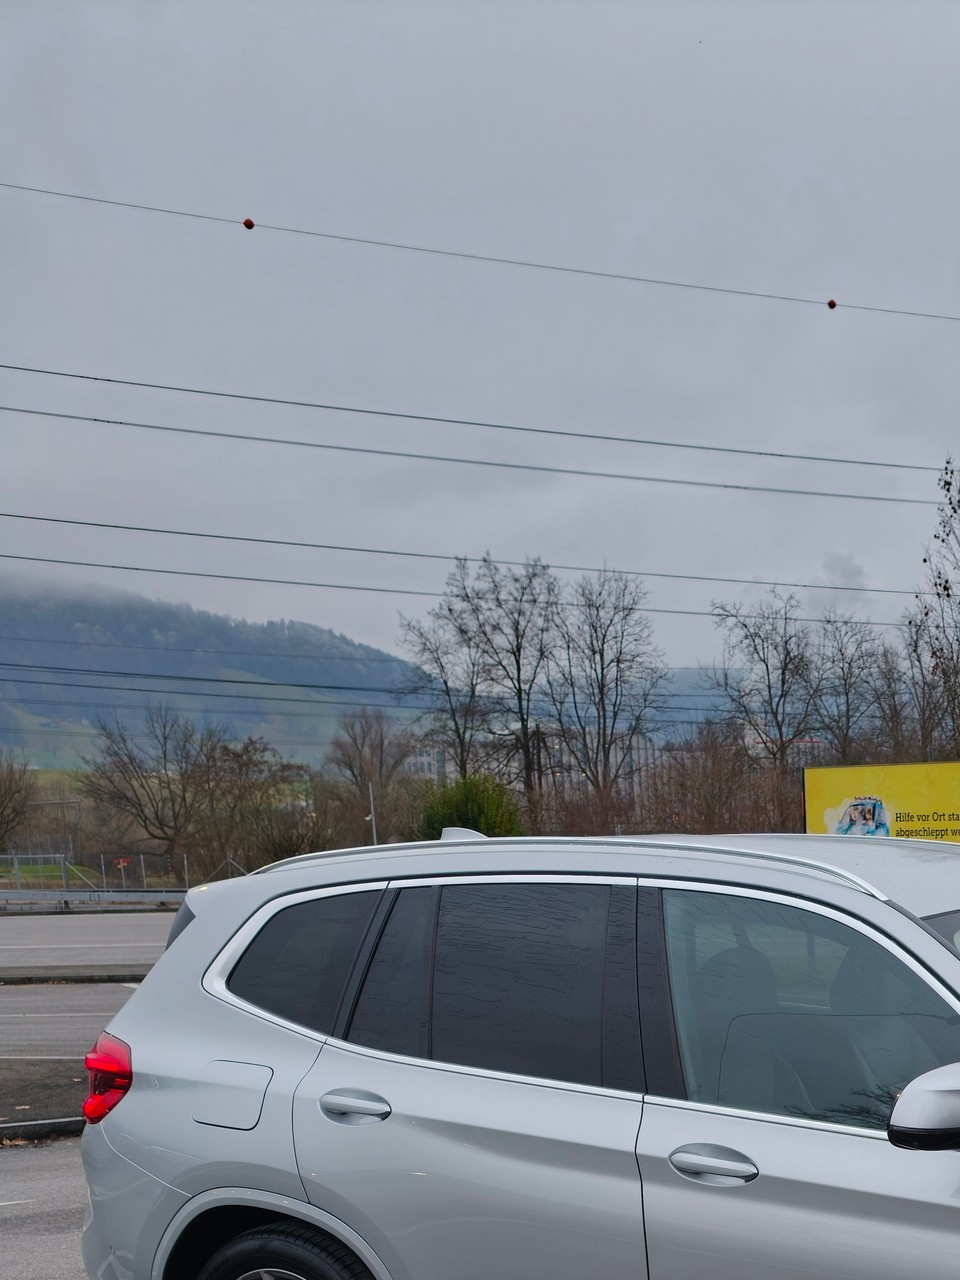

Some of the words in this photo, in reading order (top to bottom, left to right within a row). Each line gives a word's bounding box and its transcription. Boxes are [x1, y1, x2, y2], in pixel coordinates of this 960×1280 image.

[895, 812, 914, 823] Hilfe
[916, 813, 930, 822] vor
[932, 812, 946, 822] Ort
[895, 827, 949, 839] abgeschleppt
